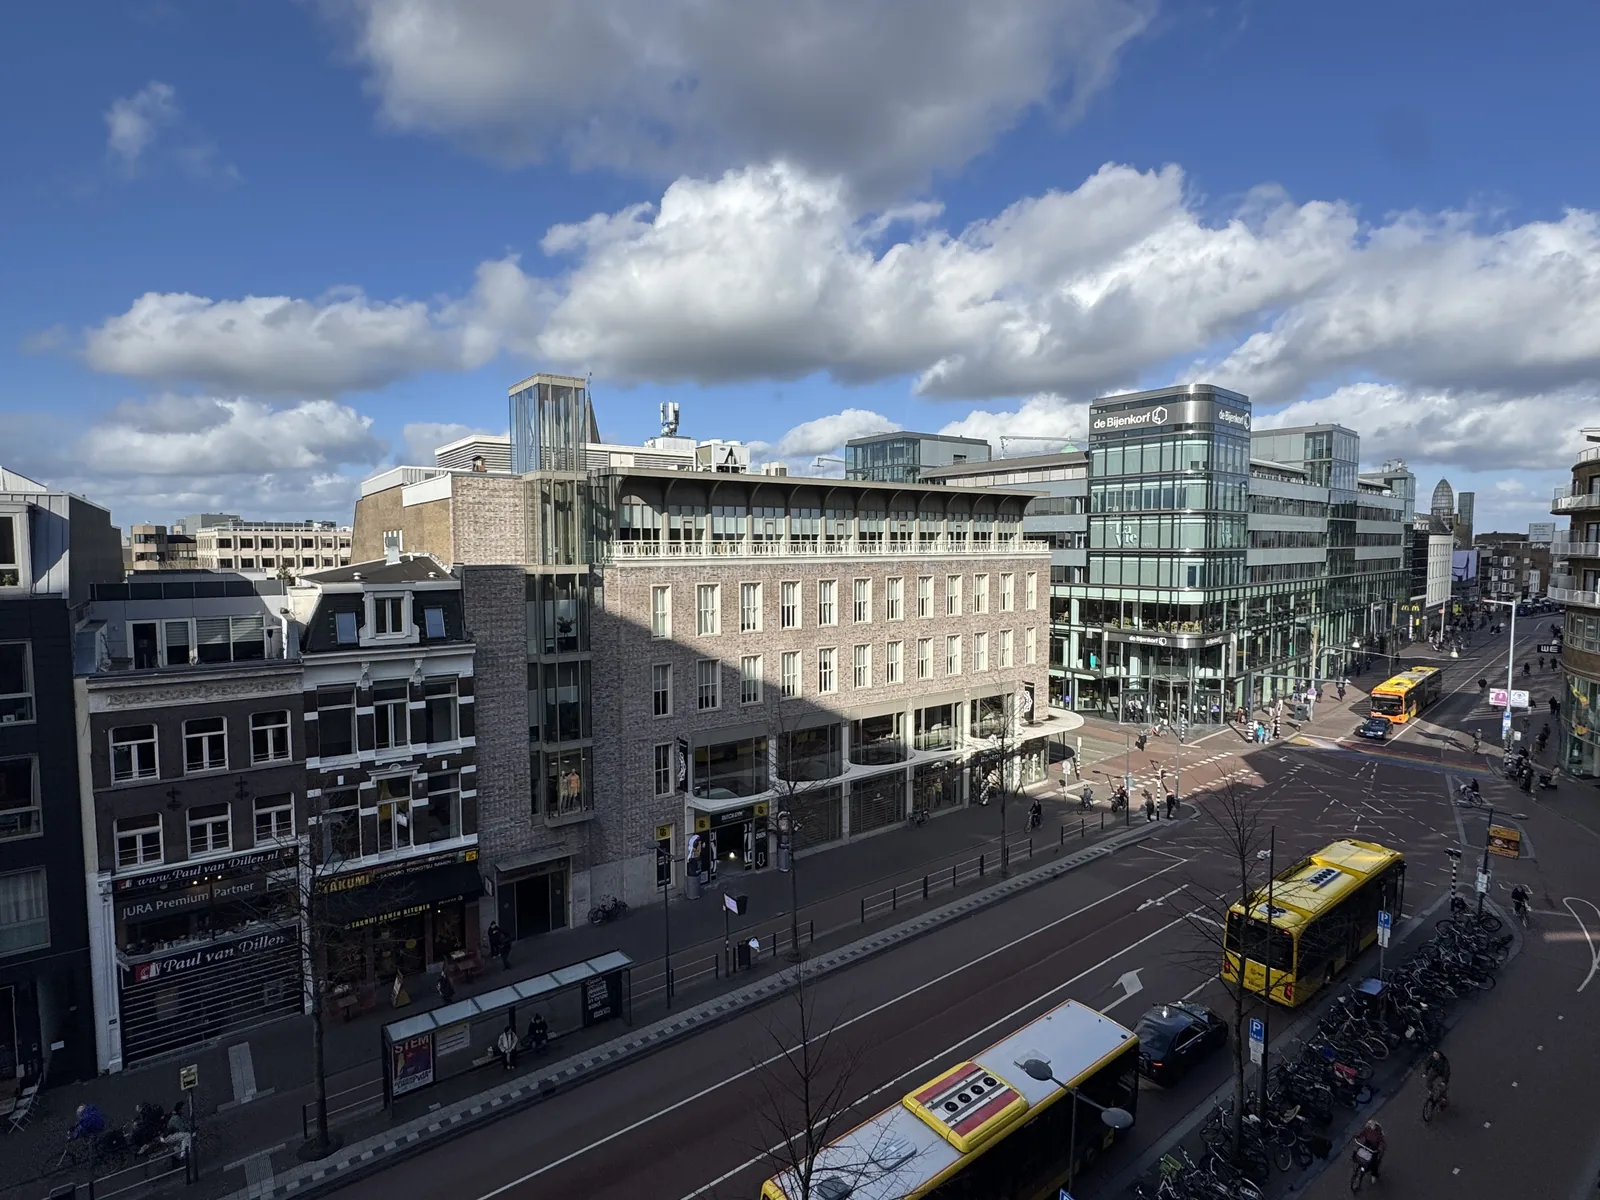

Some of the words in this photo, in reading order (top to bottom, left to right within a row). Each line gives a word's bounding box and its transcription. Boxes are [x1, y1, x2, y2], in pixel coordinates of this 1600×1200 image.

[1094, 418, 1106, 429] de
[1107, 411, 1151, 429] Bijenkorf
[1540, 645, 1558, 653] WE
[203, 862, 225, 873] van
[228, 850, 280, 868] Dillen.nl
[322, 873, 370, 894] TAKUMI
[122, 902, 153, 920] JURA
[156, 892, 209, 911] Premium
[213, 882, 255, 897] Partner
[163, 951, 201, 972] Paul
[204, 946, 235, 964] van
[239, 935, 285, 953] Dillen
[1253, 1022, 1261, 1032] P
